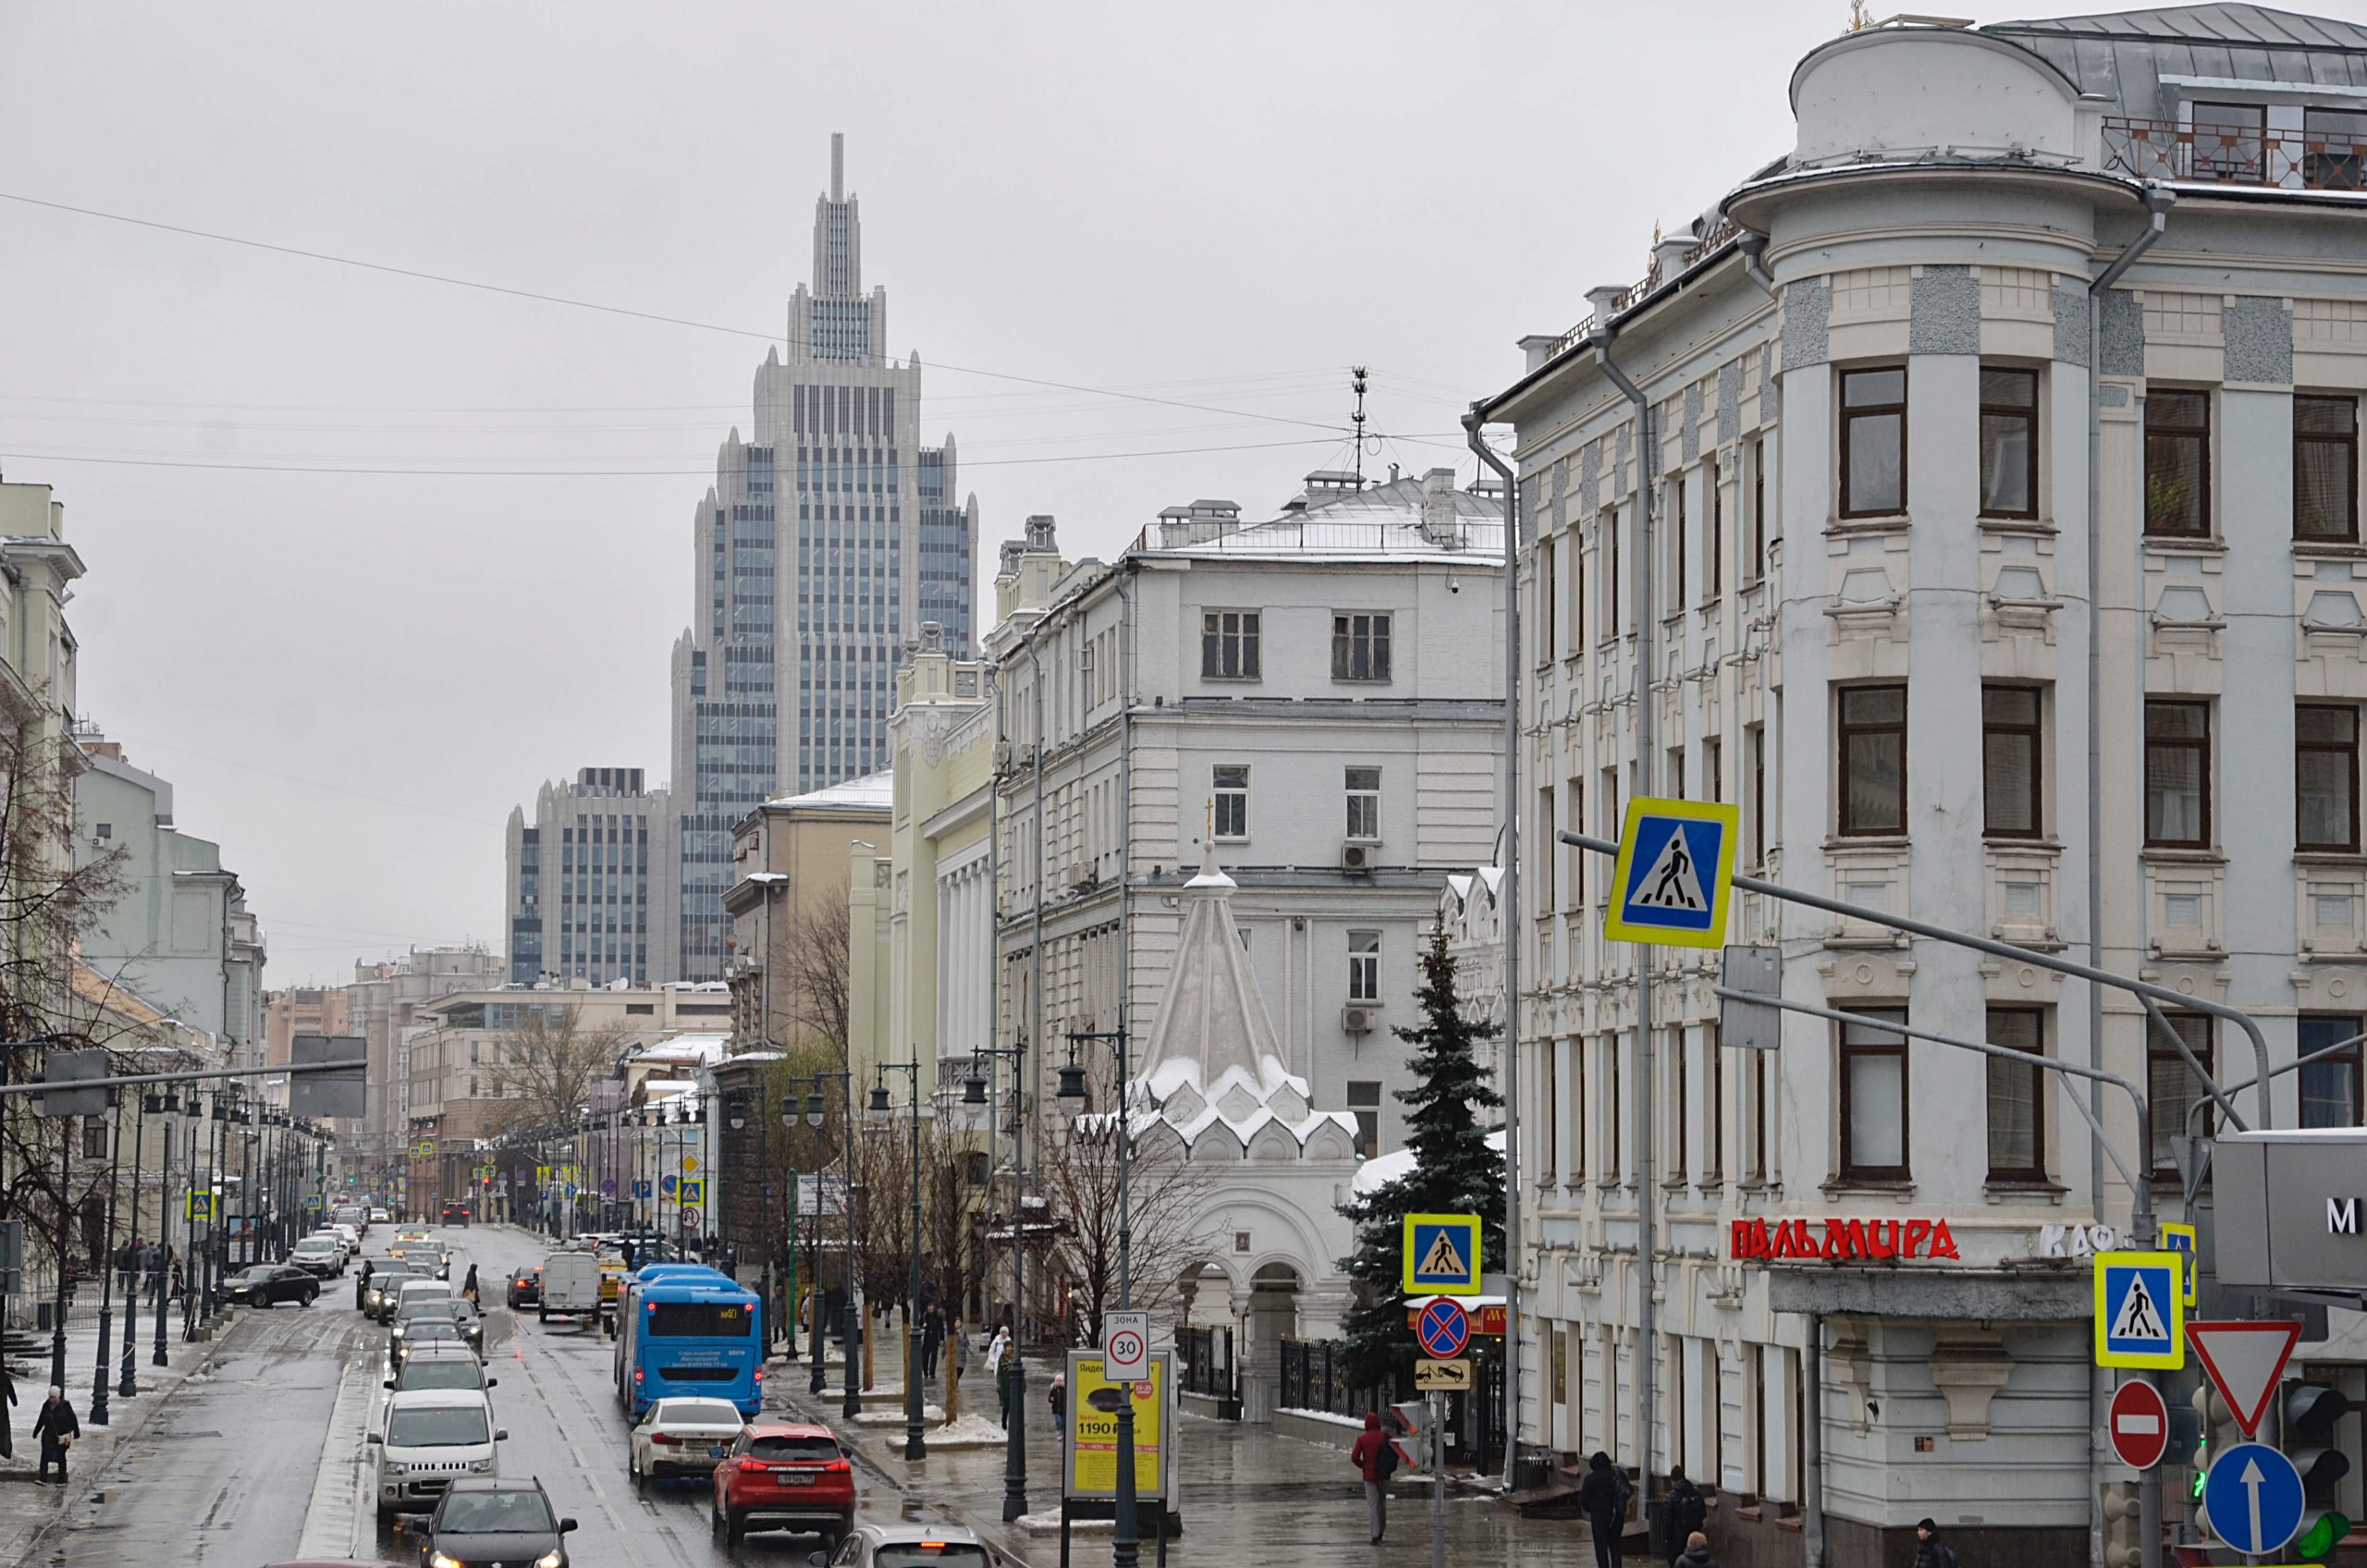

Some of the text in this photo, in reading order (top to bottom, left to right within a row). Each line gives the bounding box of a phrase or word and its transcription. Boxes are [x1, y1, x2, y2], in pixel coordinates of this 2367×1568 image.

[1731, 1218, 1960, 1260] ПАЛЬМИРА
[2039, 1223, 2115, 1258] КАФ
[1114, 1316, 1138, 1325] ЗОНА
[1117, 1341, 1136, 1354] 30
[1079, 1422, 1110, 1435] 1190
